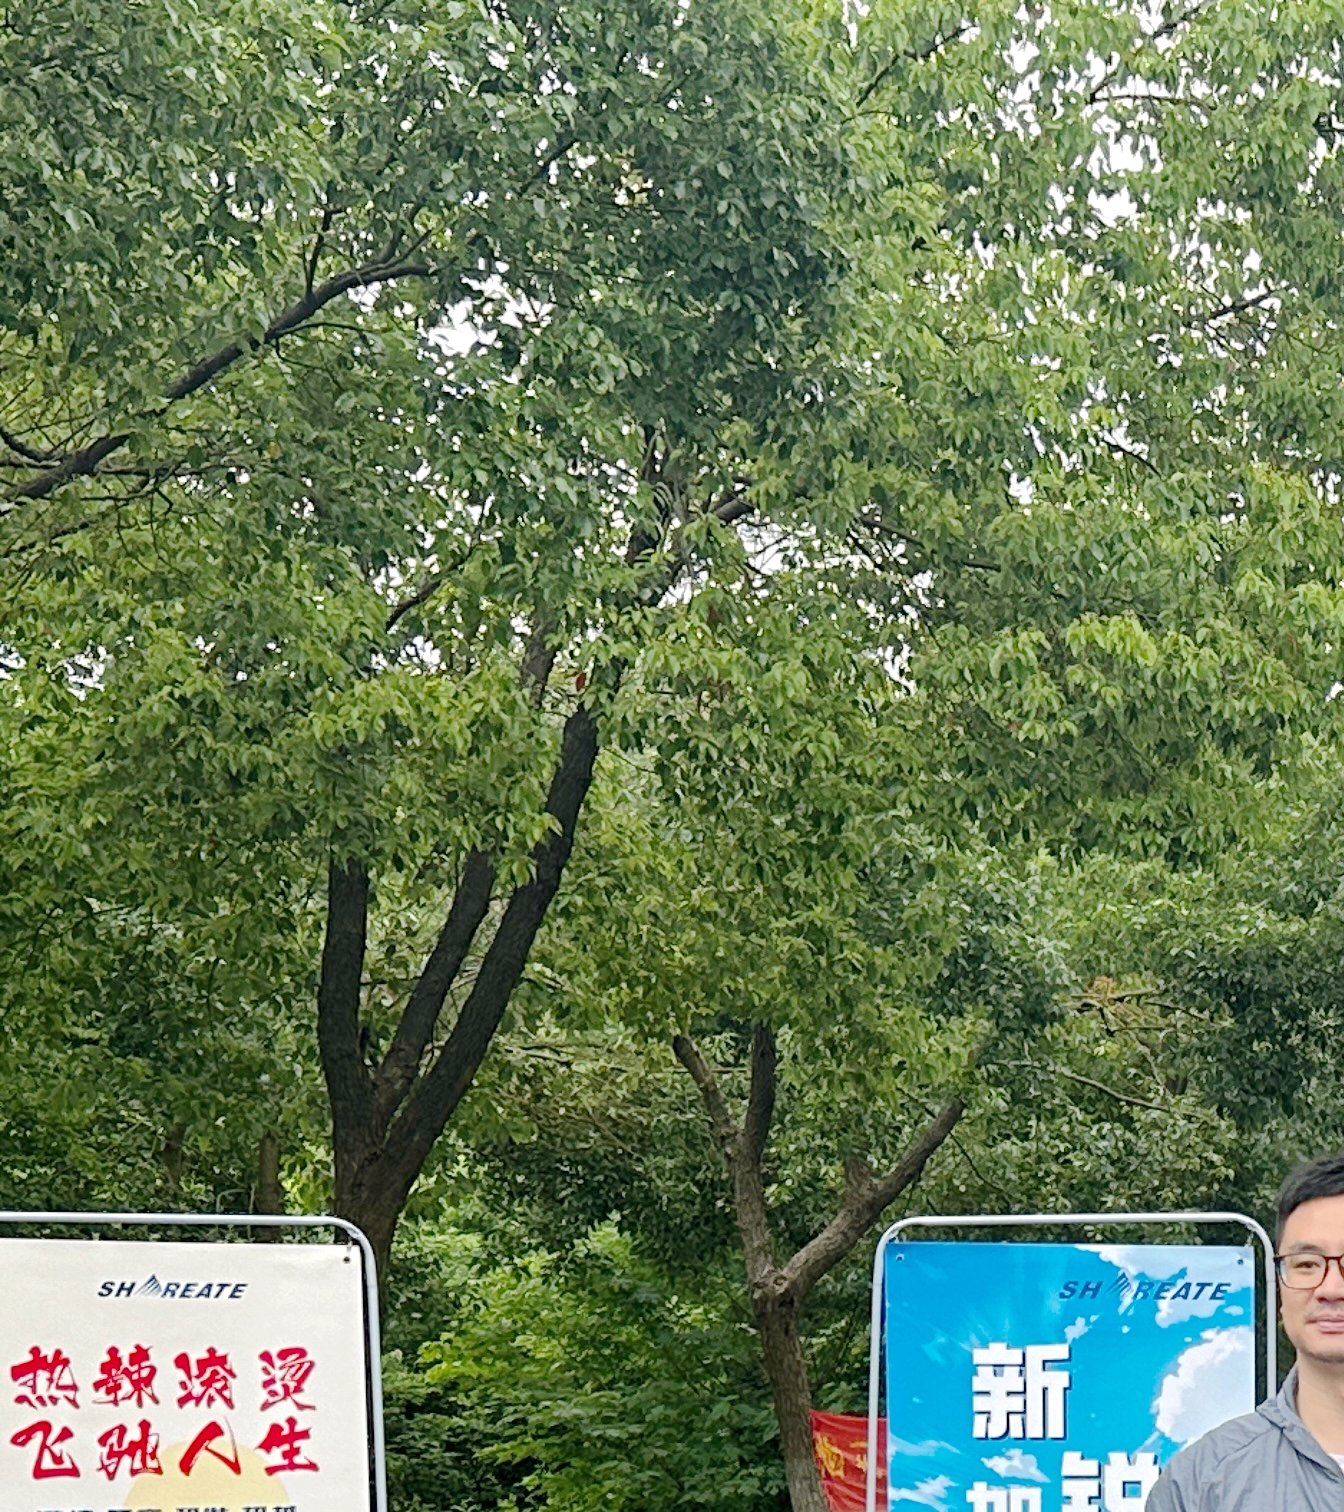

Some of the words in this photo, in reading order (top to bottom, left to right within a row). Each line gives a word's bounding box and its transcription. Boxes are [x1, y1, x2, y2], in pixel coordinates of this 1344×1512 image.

[10, 1344, 317, 1412] 热辣滚烫
[10, 1415, 320, 1481] 飞驰人生
